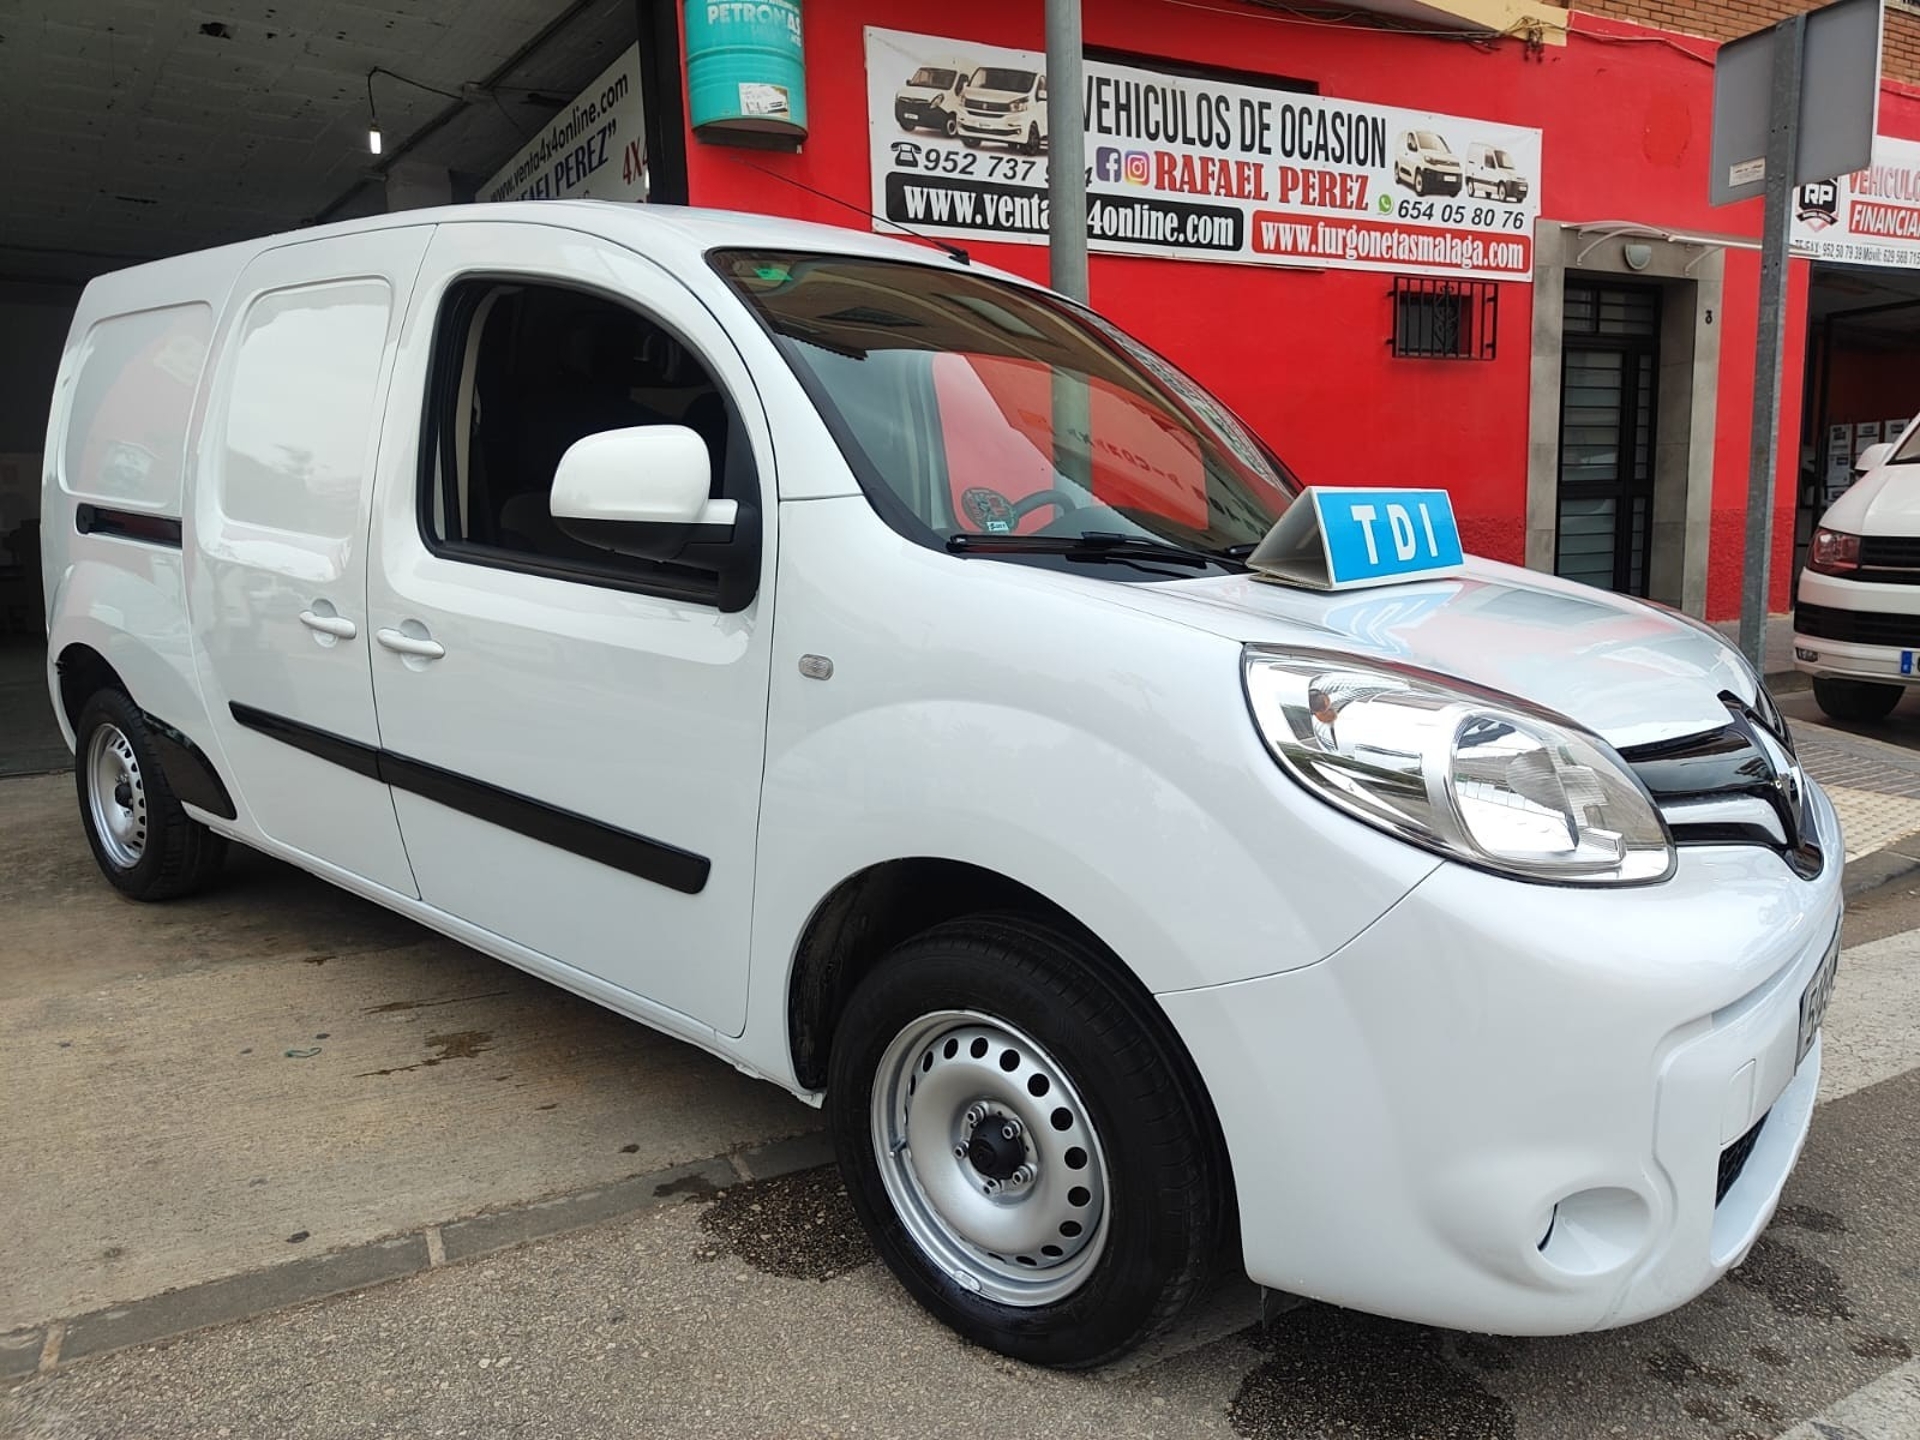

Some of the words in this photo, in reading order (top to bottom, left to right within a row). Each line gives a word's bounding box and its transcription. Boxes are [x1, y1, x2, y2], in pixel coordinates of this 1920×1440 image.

[1084, 74, 1231, 150] VEHICULOS
[1240, 97, 1271, 155] DE
[1280, 103, 1386, 168] OCASION
[923, 148, 977, 176] 952
[988, 155, 1037, 181] 737
[1155, 150, 1269, 202] RAFAEL
[1279, 165, 1369, 212] PEREZ
[903, 185, 1234, 248] www.venta4online.com
[1398, 200, 1435, 221] 654
[1441, 204, 1466, 223] 05
[1471, 208, 1495, 227] 80
[1502, 211, 1525, 229] 76
[1804, 183, 1834, 205] RP
[1260, 220, 1524, 270] www.furgonetasmalaga.com
[1851, 203, 1920, 237] FINANCIA
[1350, 504, 1440, 564] TDI
